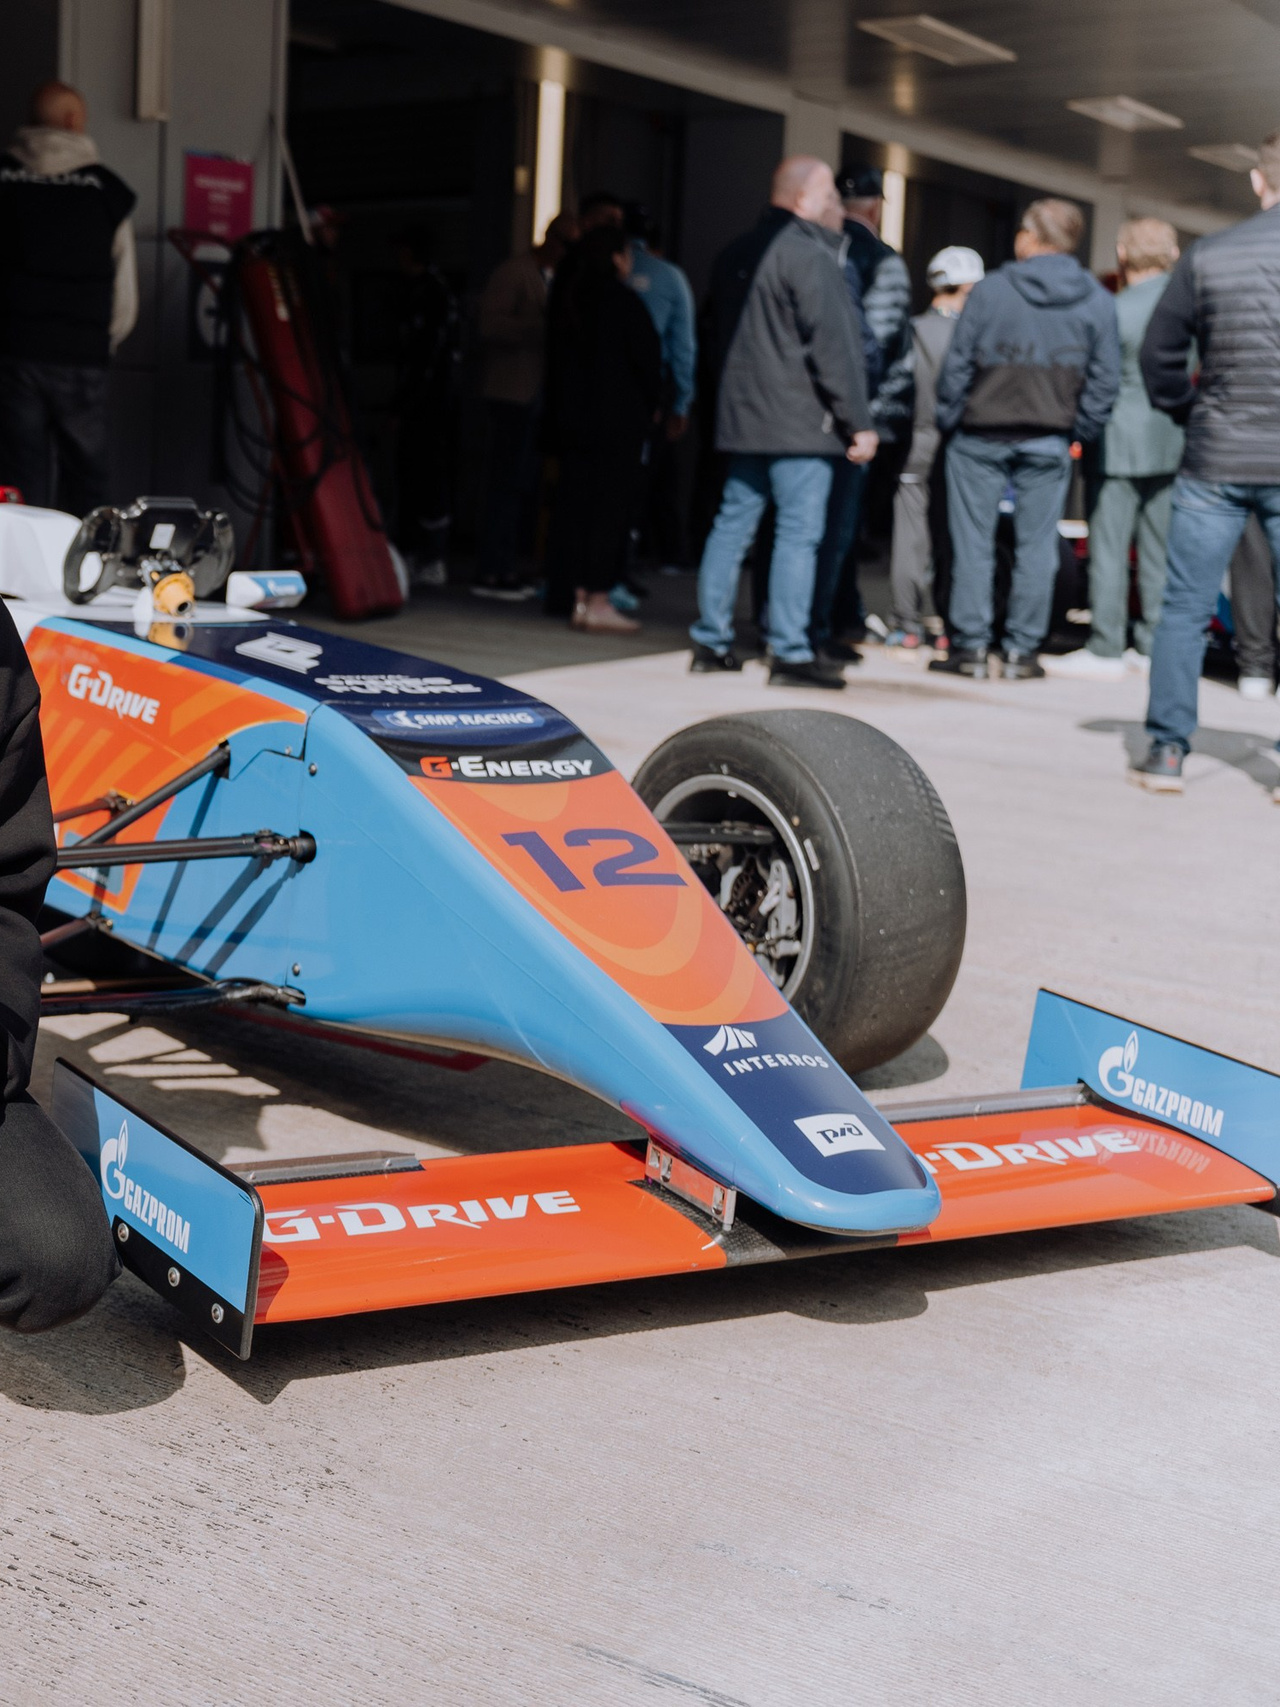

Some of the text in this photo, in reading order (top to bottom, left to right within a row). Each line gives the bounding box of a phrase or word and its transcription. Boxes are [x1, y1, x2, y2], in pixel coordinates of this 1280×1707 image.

[415, 711, 534, 726] SMP RACING
[501, 828, 688, 893] 12
[723, 1053, 829, 1076] INTERROS
[1131, 1081, 1225, 1138] GAZPROM
[123, 1179, 191, 1254] GAZPROM
